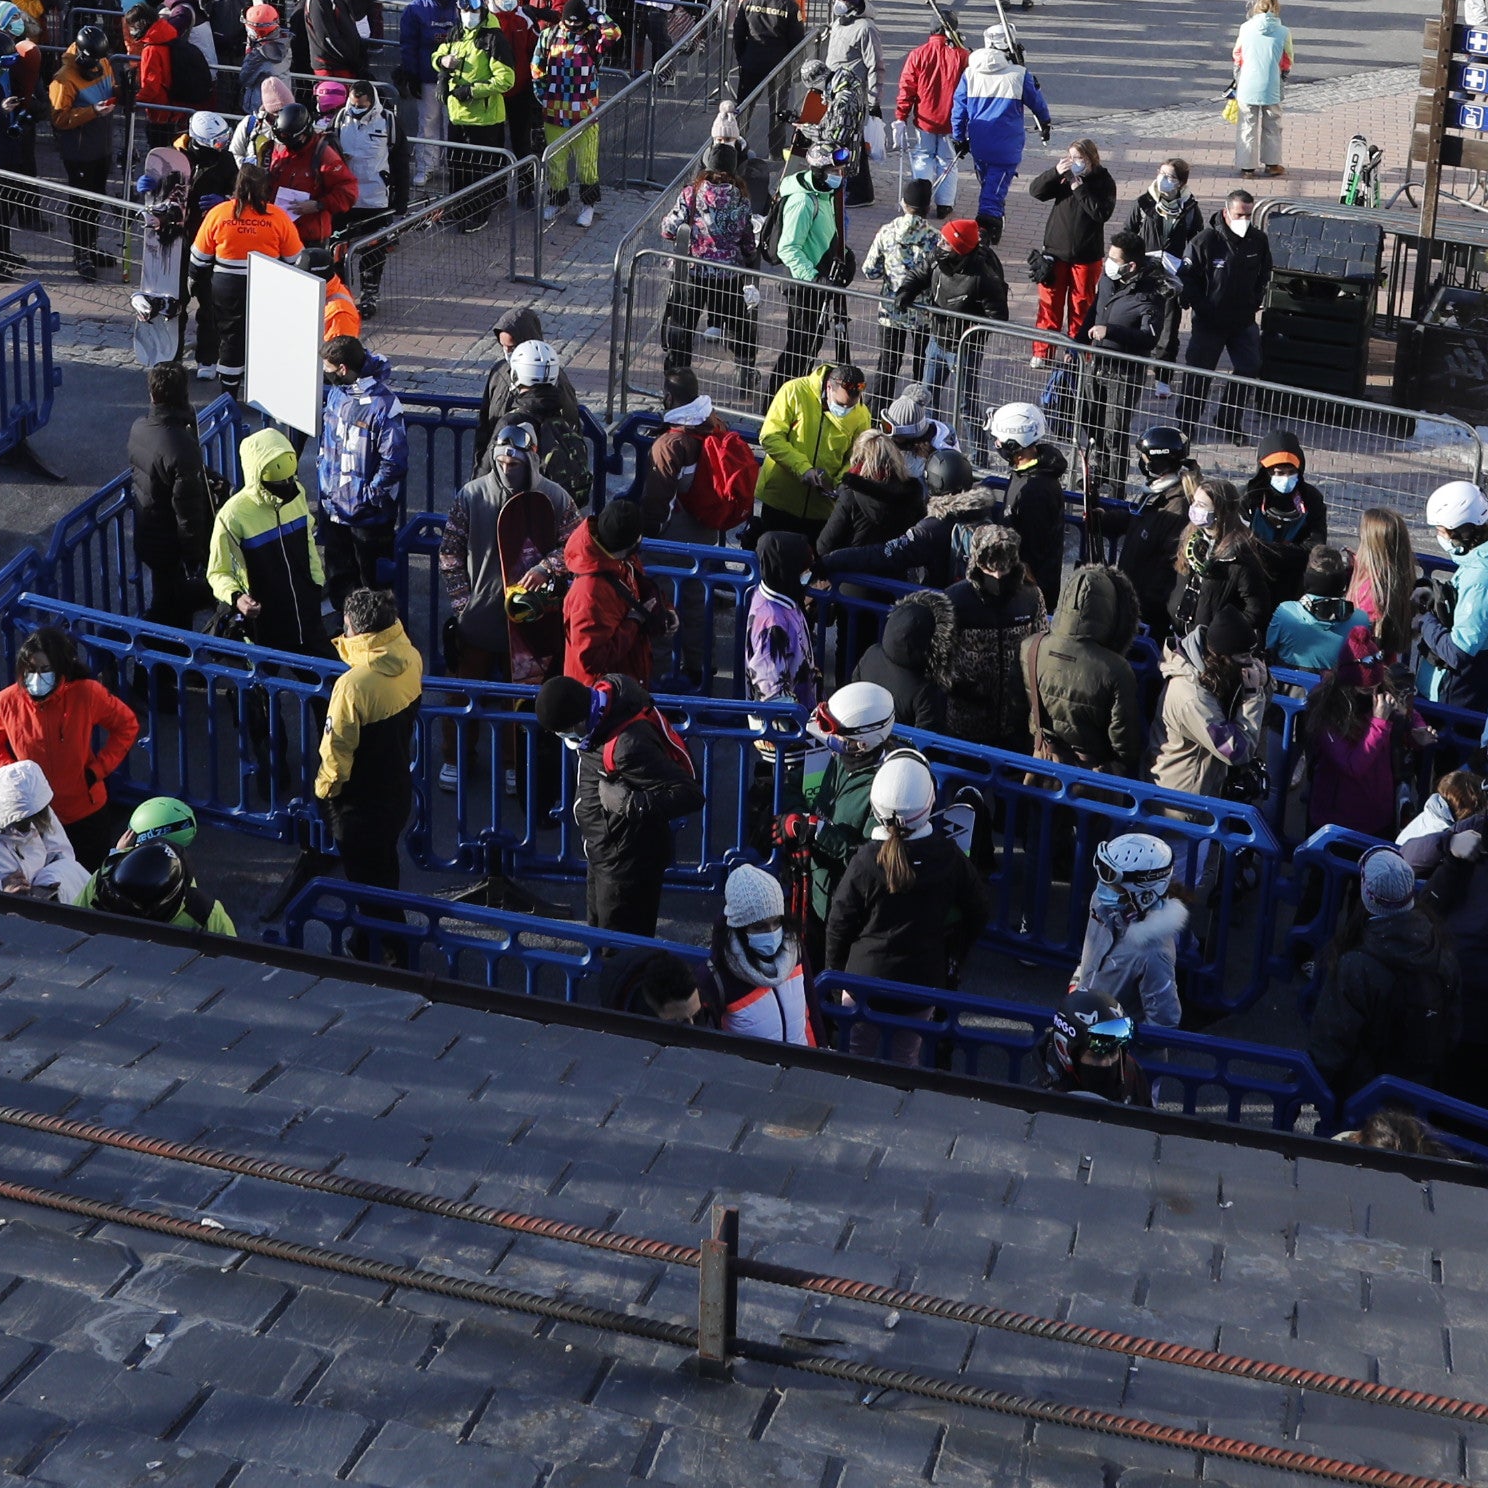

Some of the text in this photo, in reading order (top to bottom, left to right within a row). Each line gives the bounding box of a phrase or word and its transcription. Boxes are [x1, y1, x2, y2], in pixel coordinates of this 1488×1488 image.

[1345, 153, 1360, 193] HEAD
[222, 218, 272, 228] PROTECCIÓN
[236, 226, 257, 234] CIVIL
